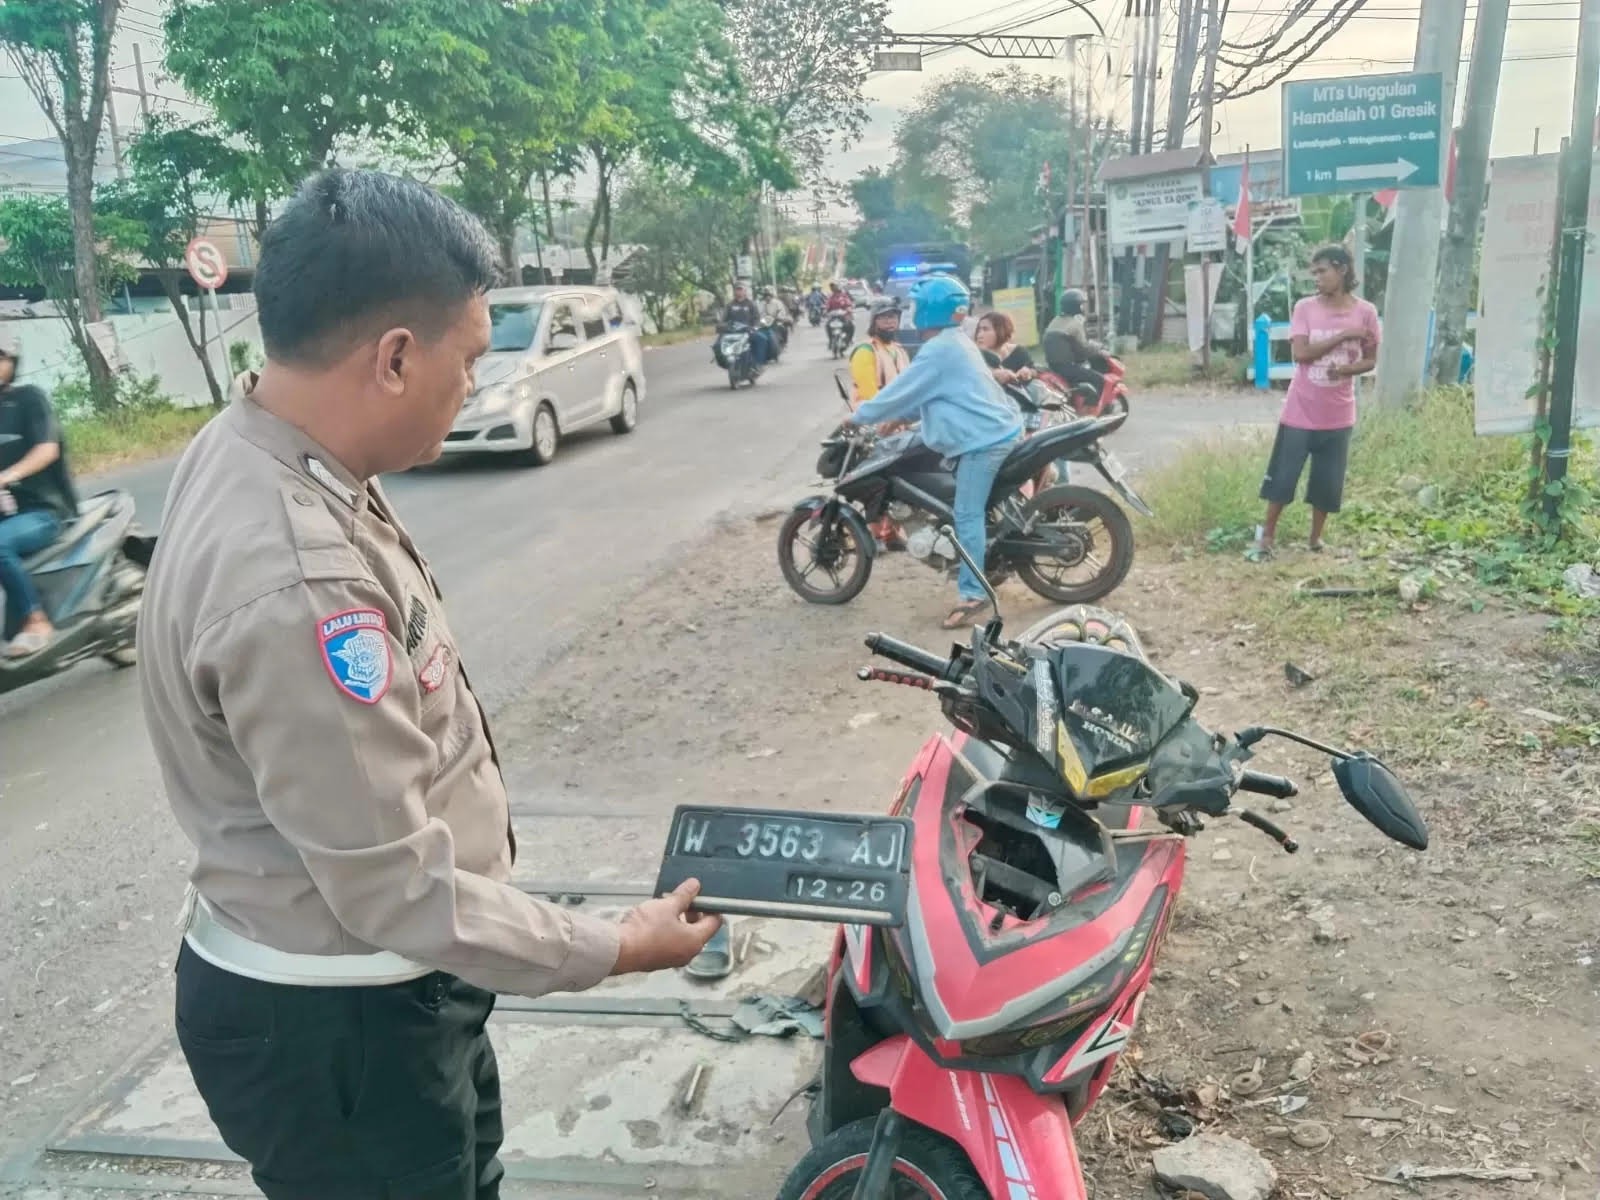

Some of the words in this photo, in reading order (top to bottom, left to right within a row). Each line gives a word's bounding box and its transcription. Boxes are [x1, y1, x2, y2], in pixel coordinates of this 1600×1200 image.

[1313, 86, 1344, 102] MTs
[1348, 81, 1417, 101] Unggulan
[1292, 107, 1366, 126] Hamdalah
[1369, 105, 1386, 120] 01
[1391, 101, 1436, 118] Gresik
[1306, 170, 1312, 181] 1
[1315, 169, 1332, 181] km
[323, 614, 352, 636] LALU
[1081, 720, 1133, 753] HONDA
[684, 818, 711, 853] W
[737, 823, 824, 860] 3563
[850, 832, 896, 867] AJ
